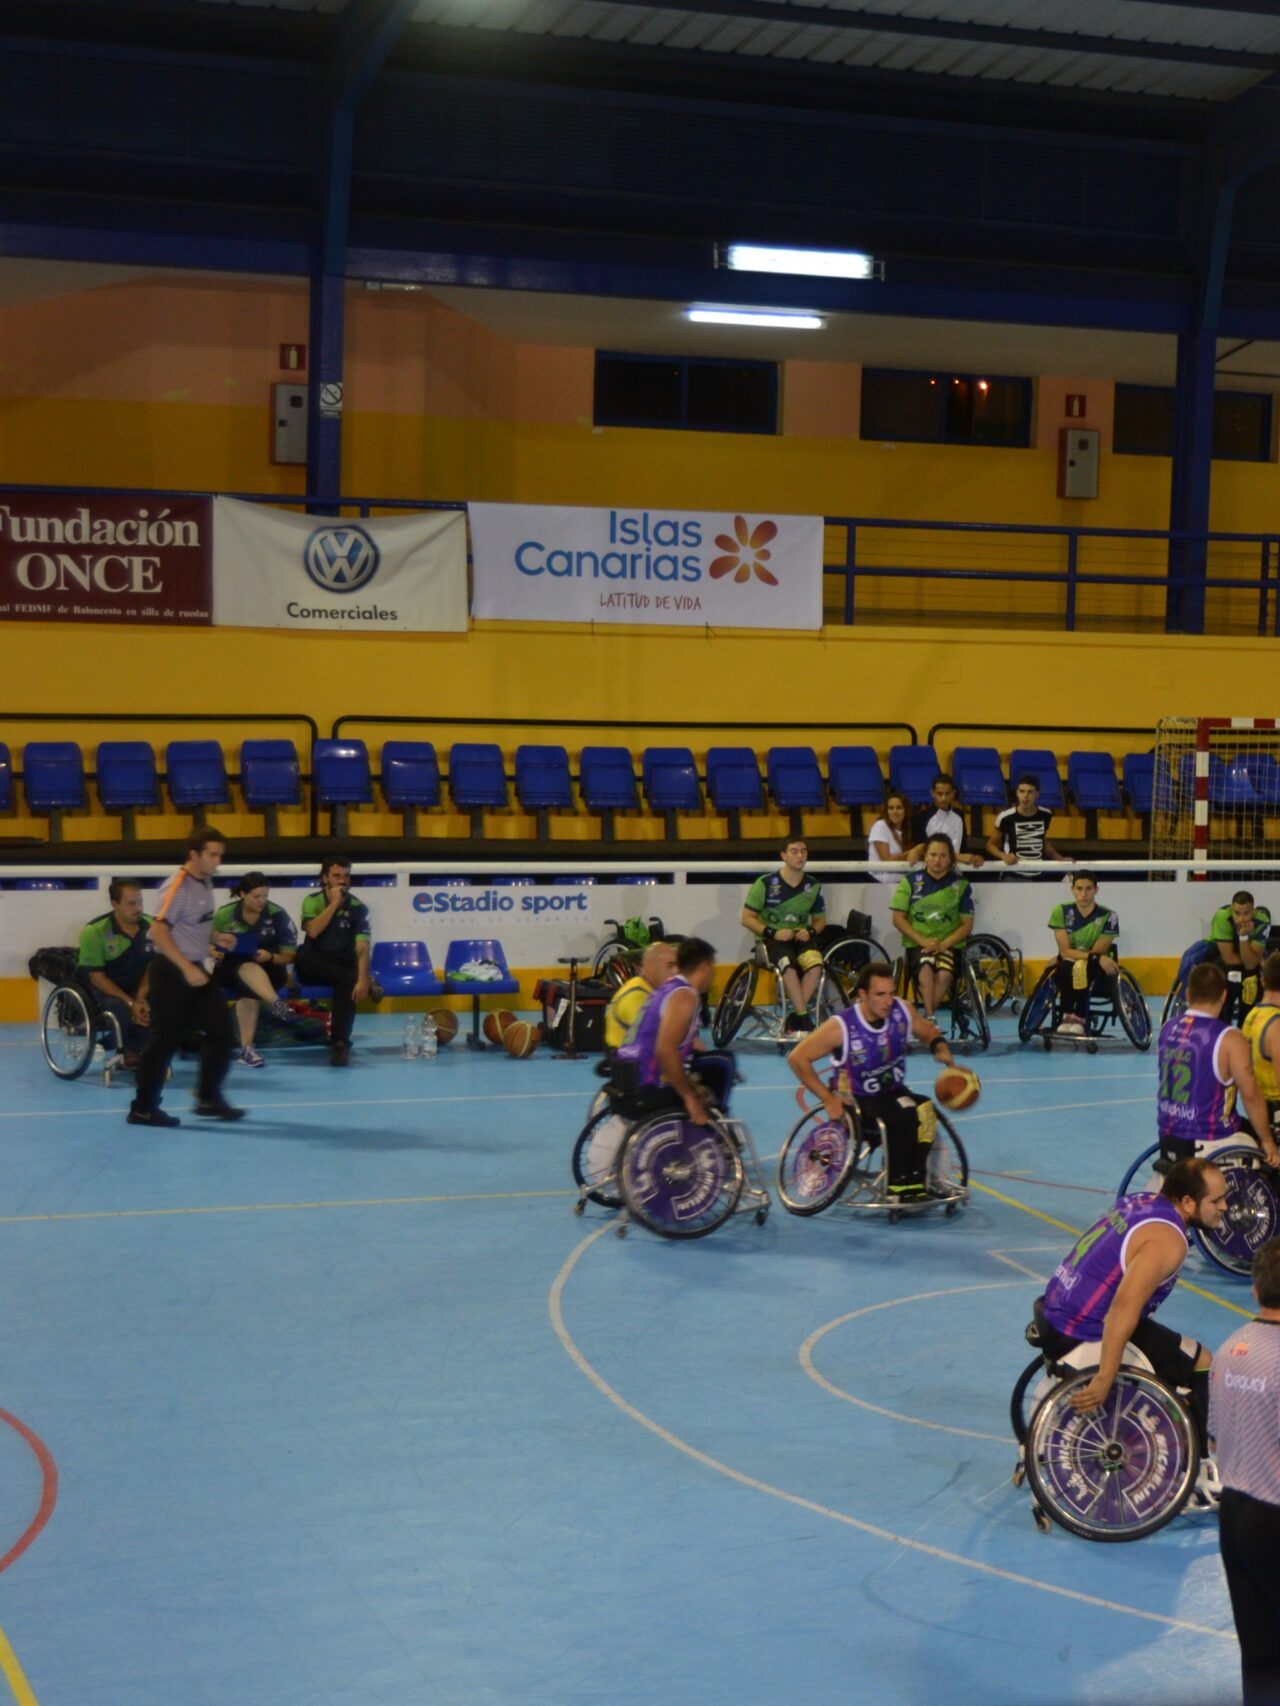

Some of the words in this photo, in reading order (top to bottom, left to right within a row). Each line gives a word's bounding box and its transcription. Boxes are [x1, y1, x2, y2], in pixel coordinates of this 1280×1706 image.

[610, 510, 703, 547] Islas
[16, 551, 164, 593] ONCE
[514, 541, 703, 582] Canarias
[58, 605, 69, 614] de
[73, 605, 122, 616] Baloncesto
[126, 609, 137, 617] en
[141, 608, 159, 617] silla
[164, 608, 176, 617] de
[286, 602, 398, 620] Comerciales
[600, 592, 650, 610] LATITUD
[655, 595, 670, 609] DE
[674, 595, 702, 611] VIDA
[412, 890, 514, 913] eStadio
[521, 893, 588, 914] sport
[1161, 1061, 1192, 1105] 12
[1132, 1433, 1169, 1505] MICHELIN
